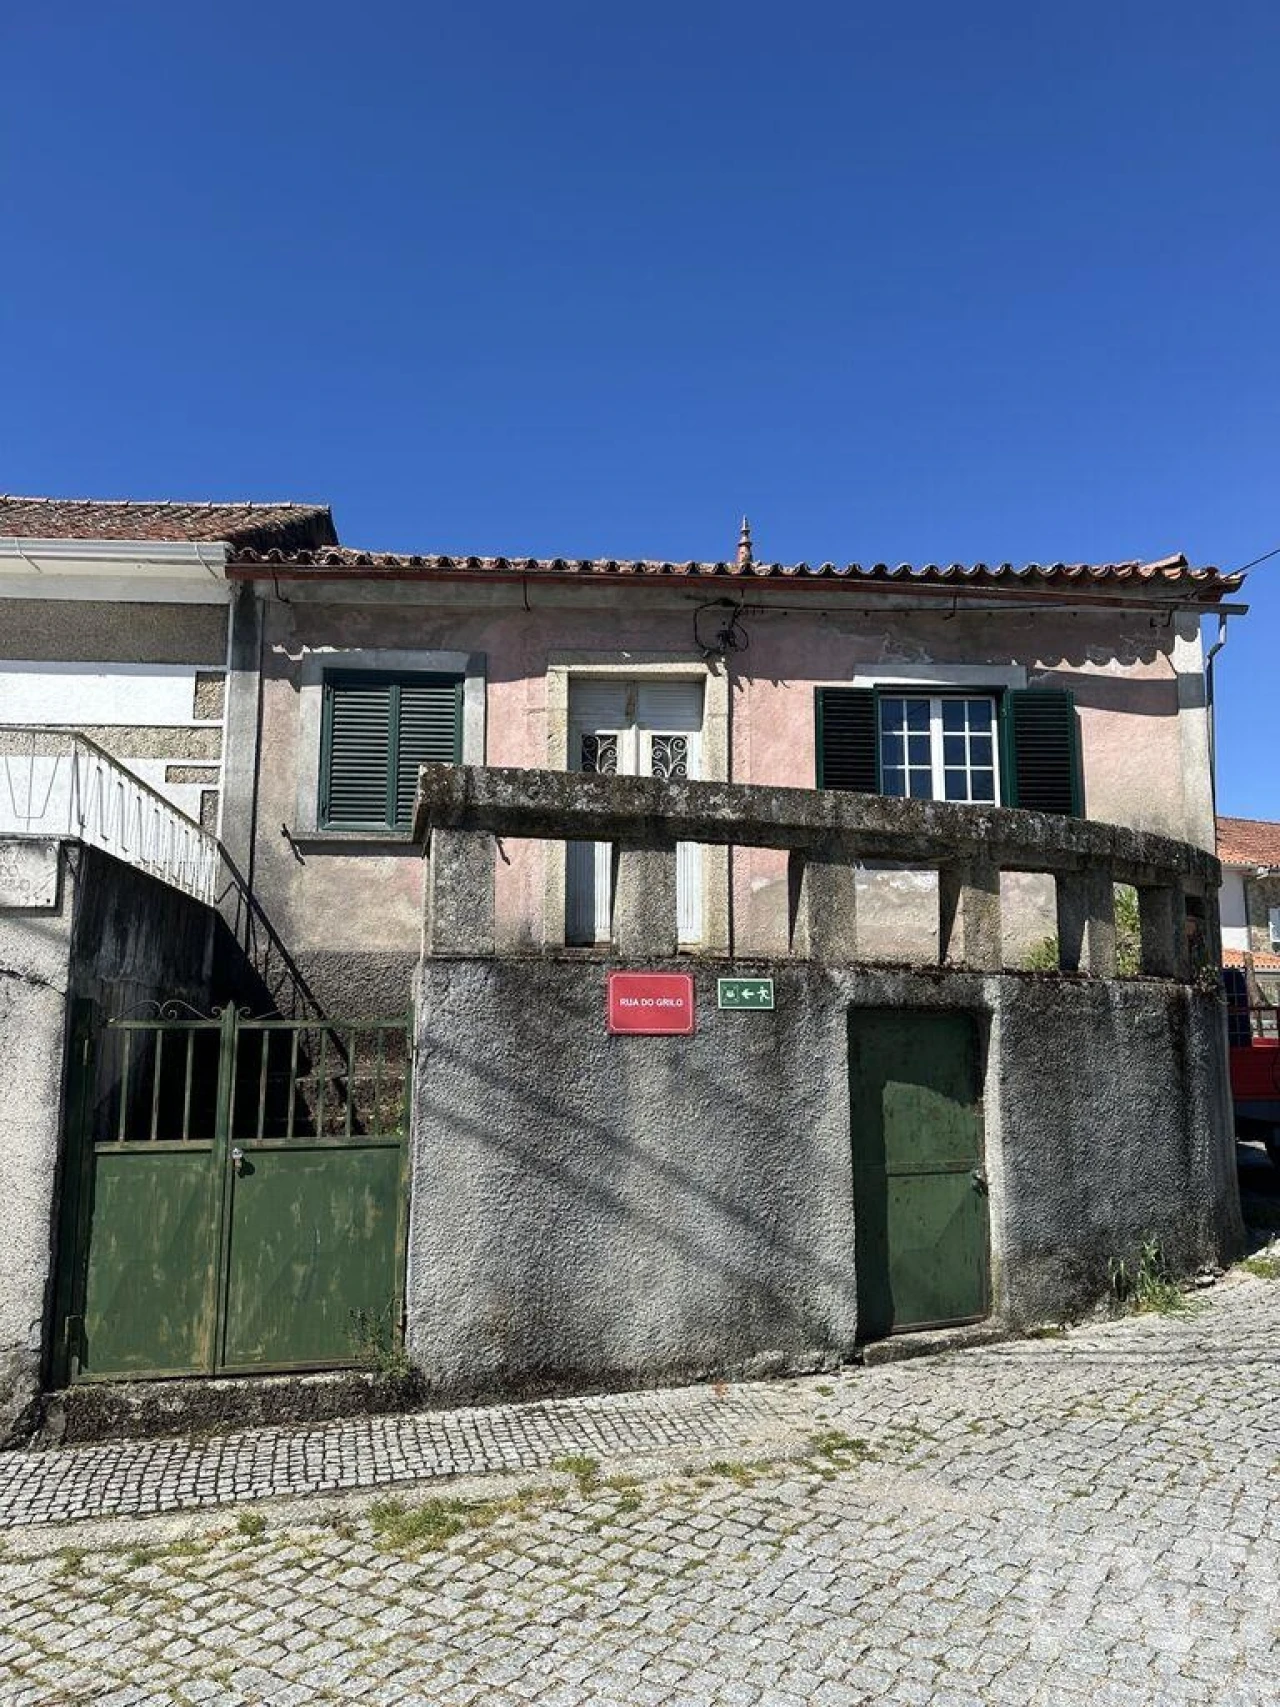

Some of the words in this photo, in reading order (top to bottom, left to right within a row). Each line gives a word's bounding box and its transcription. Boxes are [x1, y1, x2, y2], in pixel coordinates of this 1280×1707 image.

[620, 998, 639, 1006] RUA
[641, 998, 653, 1006] DO
[656, 998, 682, 1006] GRILO
